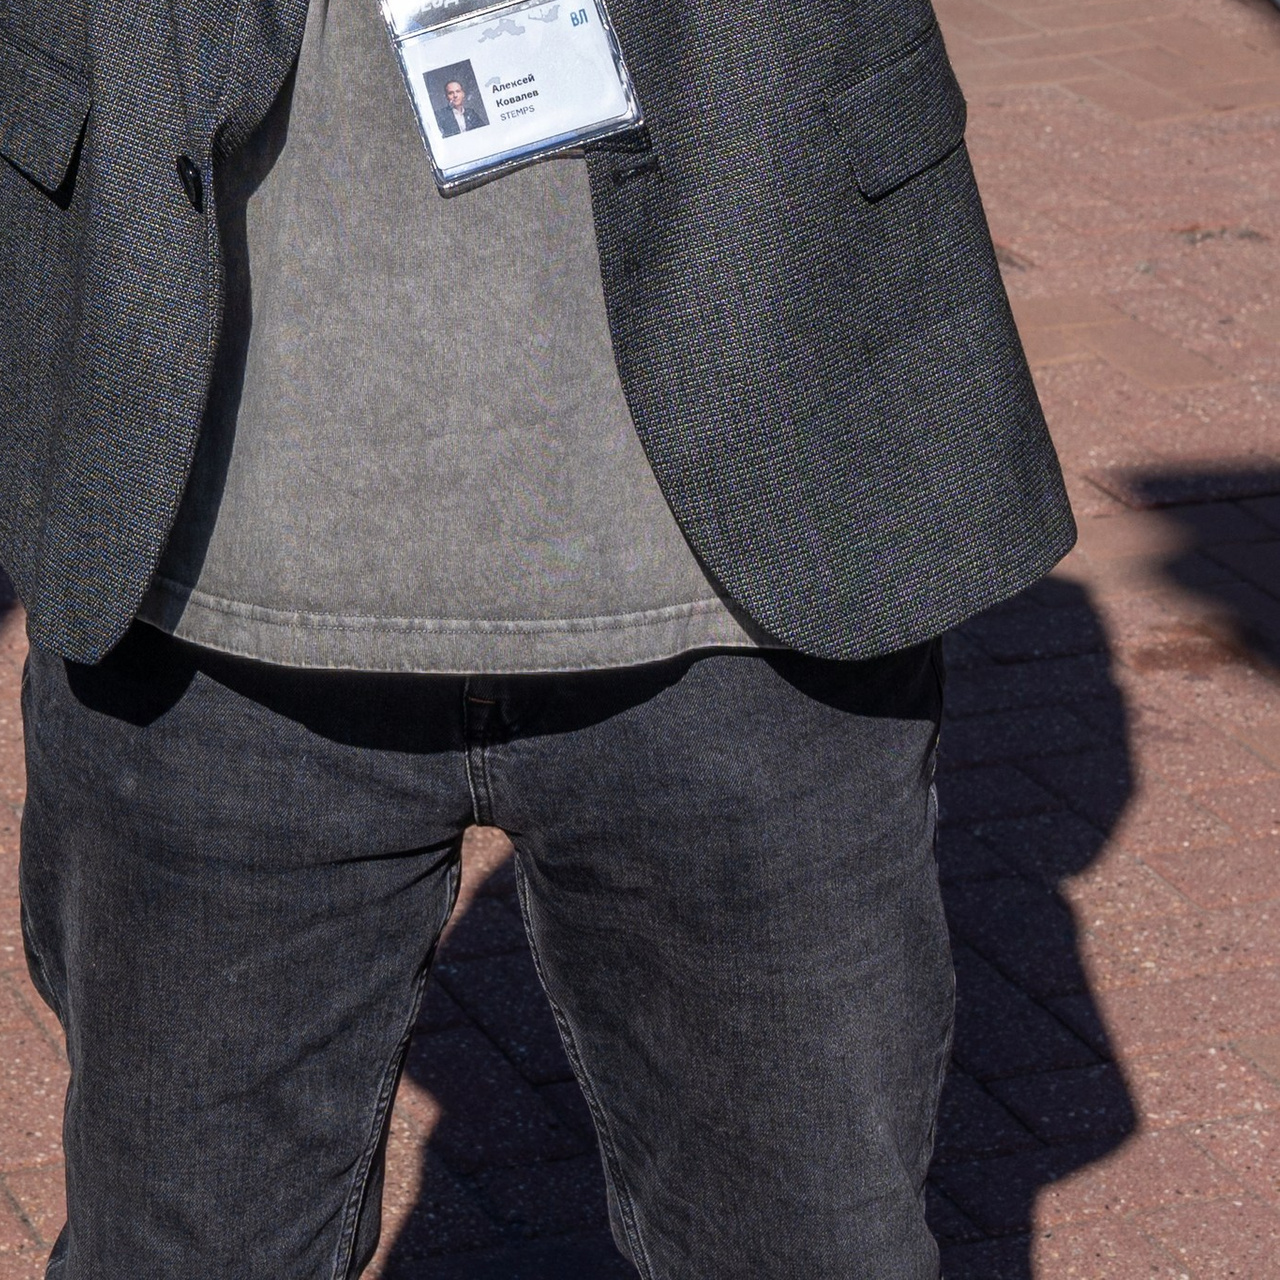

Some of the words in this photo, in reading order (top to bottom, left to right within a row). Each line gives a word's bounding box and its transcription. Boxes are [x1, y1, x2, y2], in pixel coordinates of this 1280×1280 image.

[570, 8, 589, 28] ВЛ
[491, 73, 536, 94] Алексей
[495, 89, 540, 108] Ковалев
[500, 104, 536, 122] STEMPS
